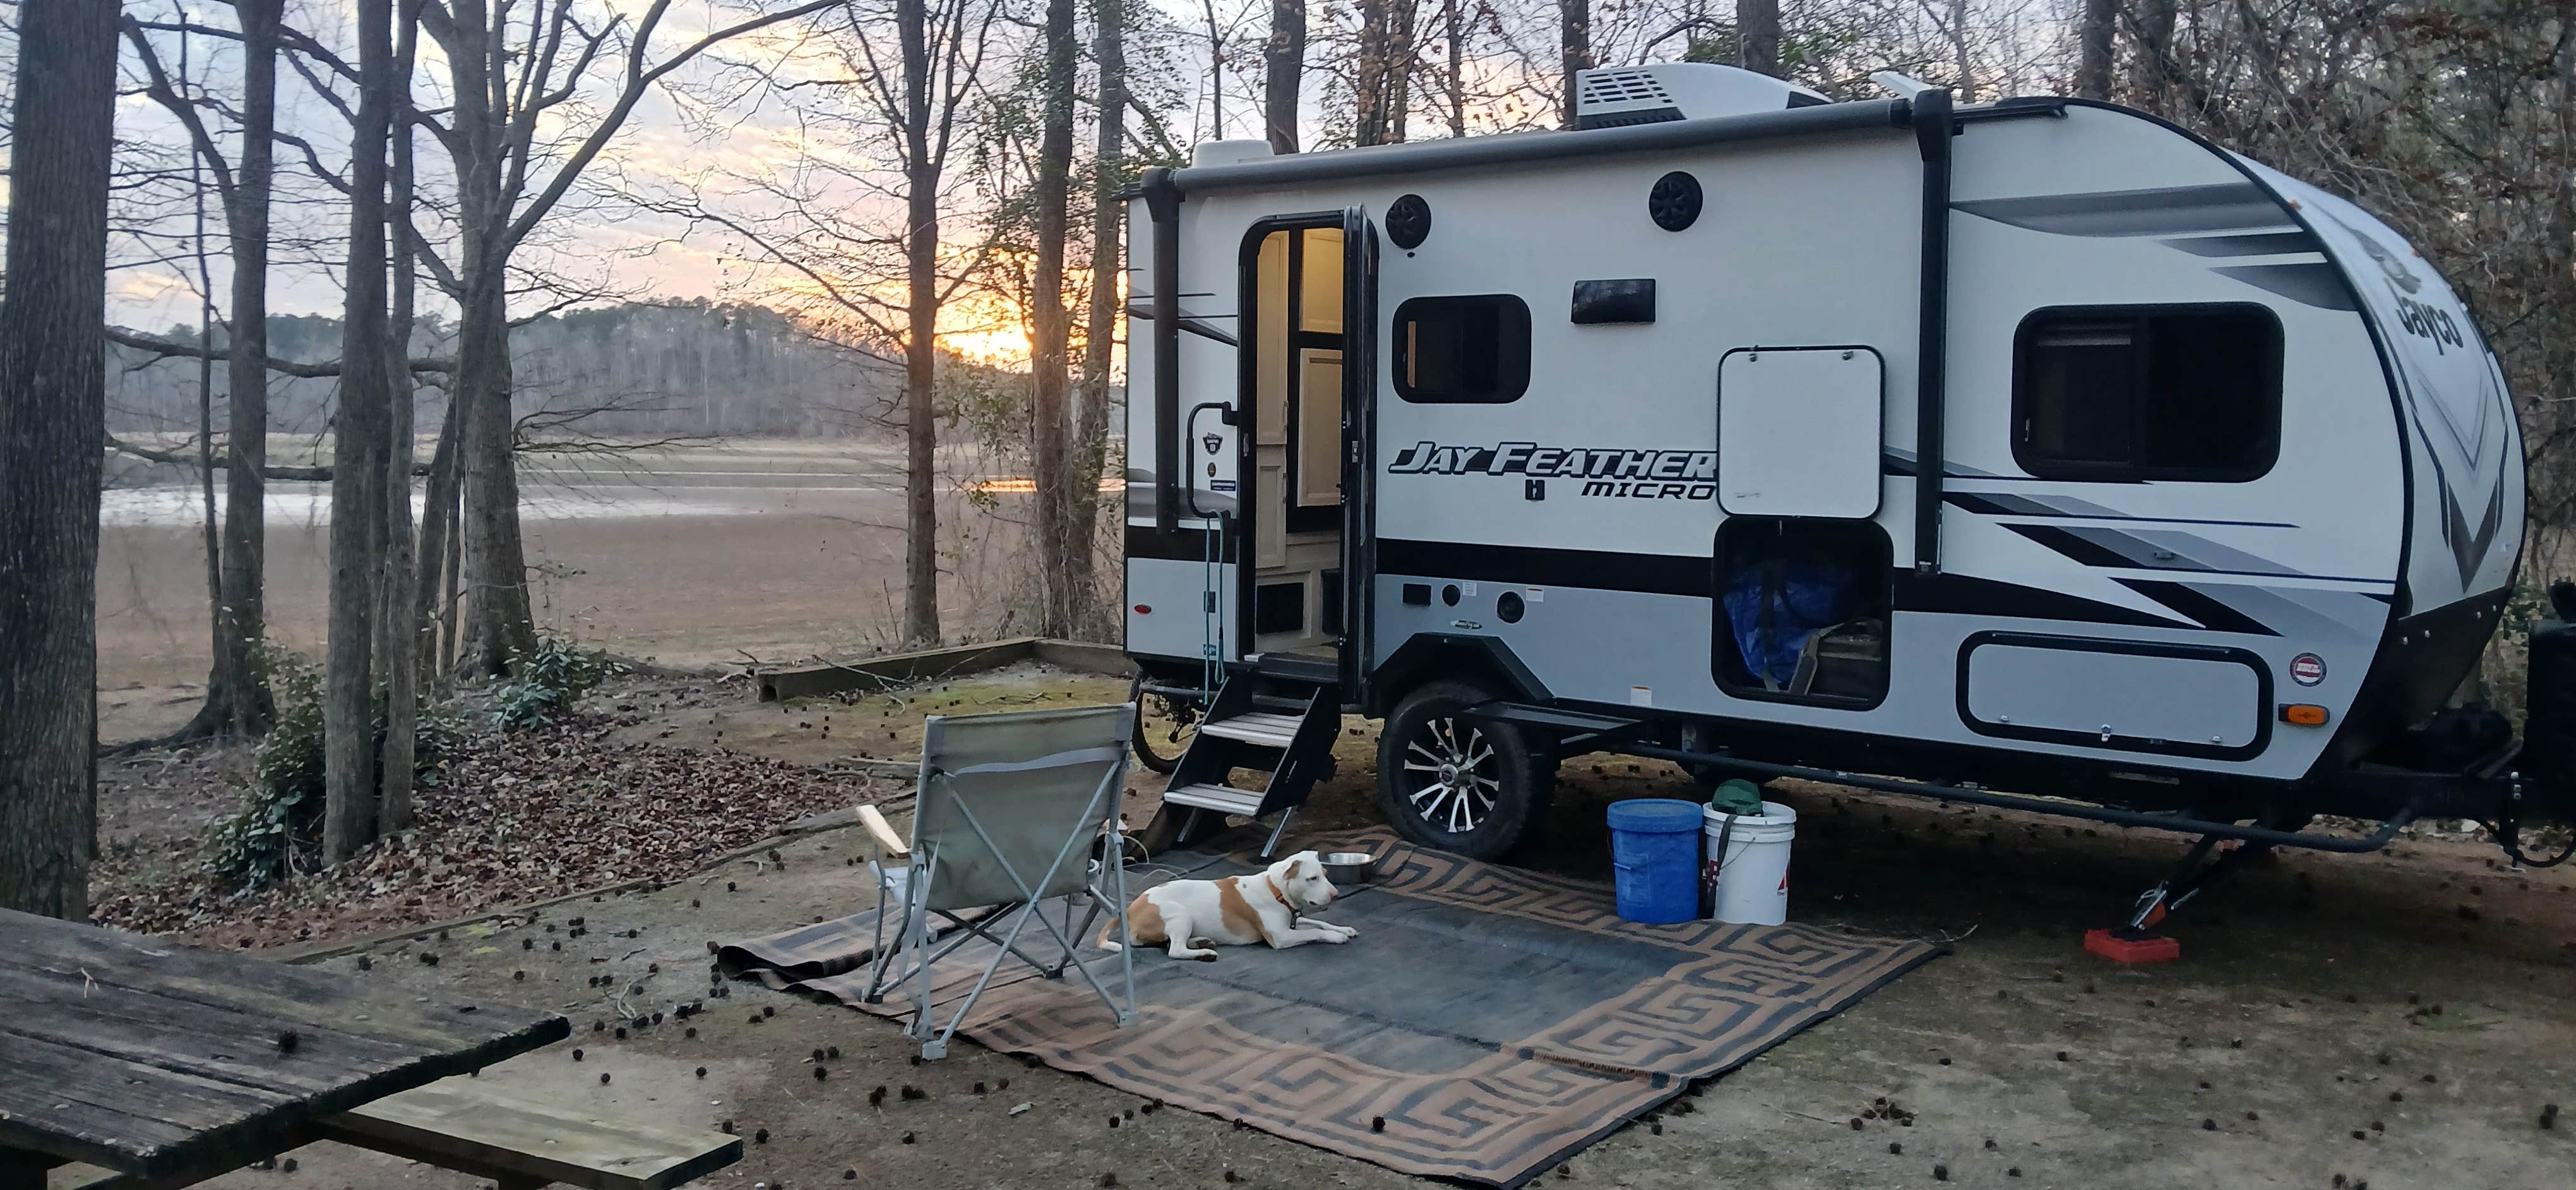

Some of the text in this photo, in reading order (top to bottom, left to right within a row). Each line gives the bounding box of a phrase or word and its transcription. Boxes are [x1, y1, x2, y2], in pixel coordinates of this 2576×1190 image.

[2383, 276, 2464, 356] Jayco
[1388, 442, 1718, 481] JAY FEATHER
[1582, 481, 1717, 500] MICRO
